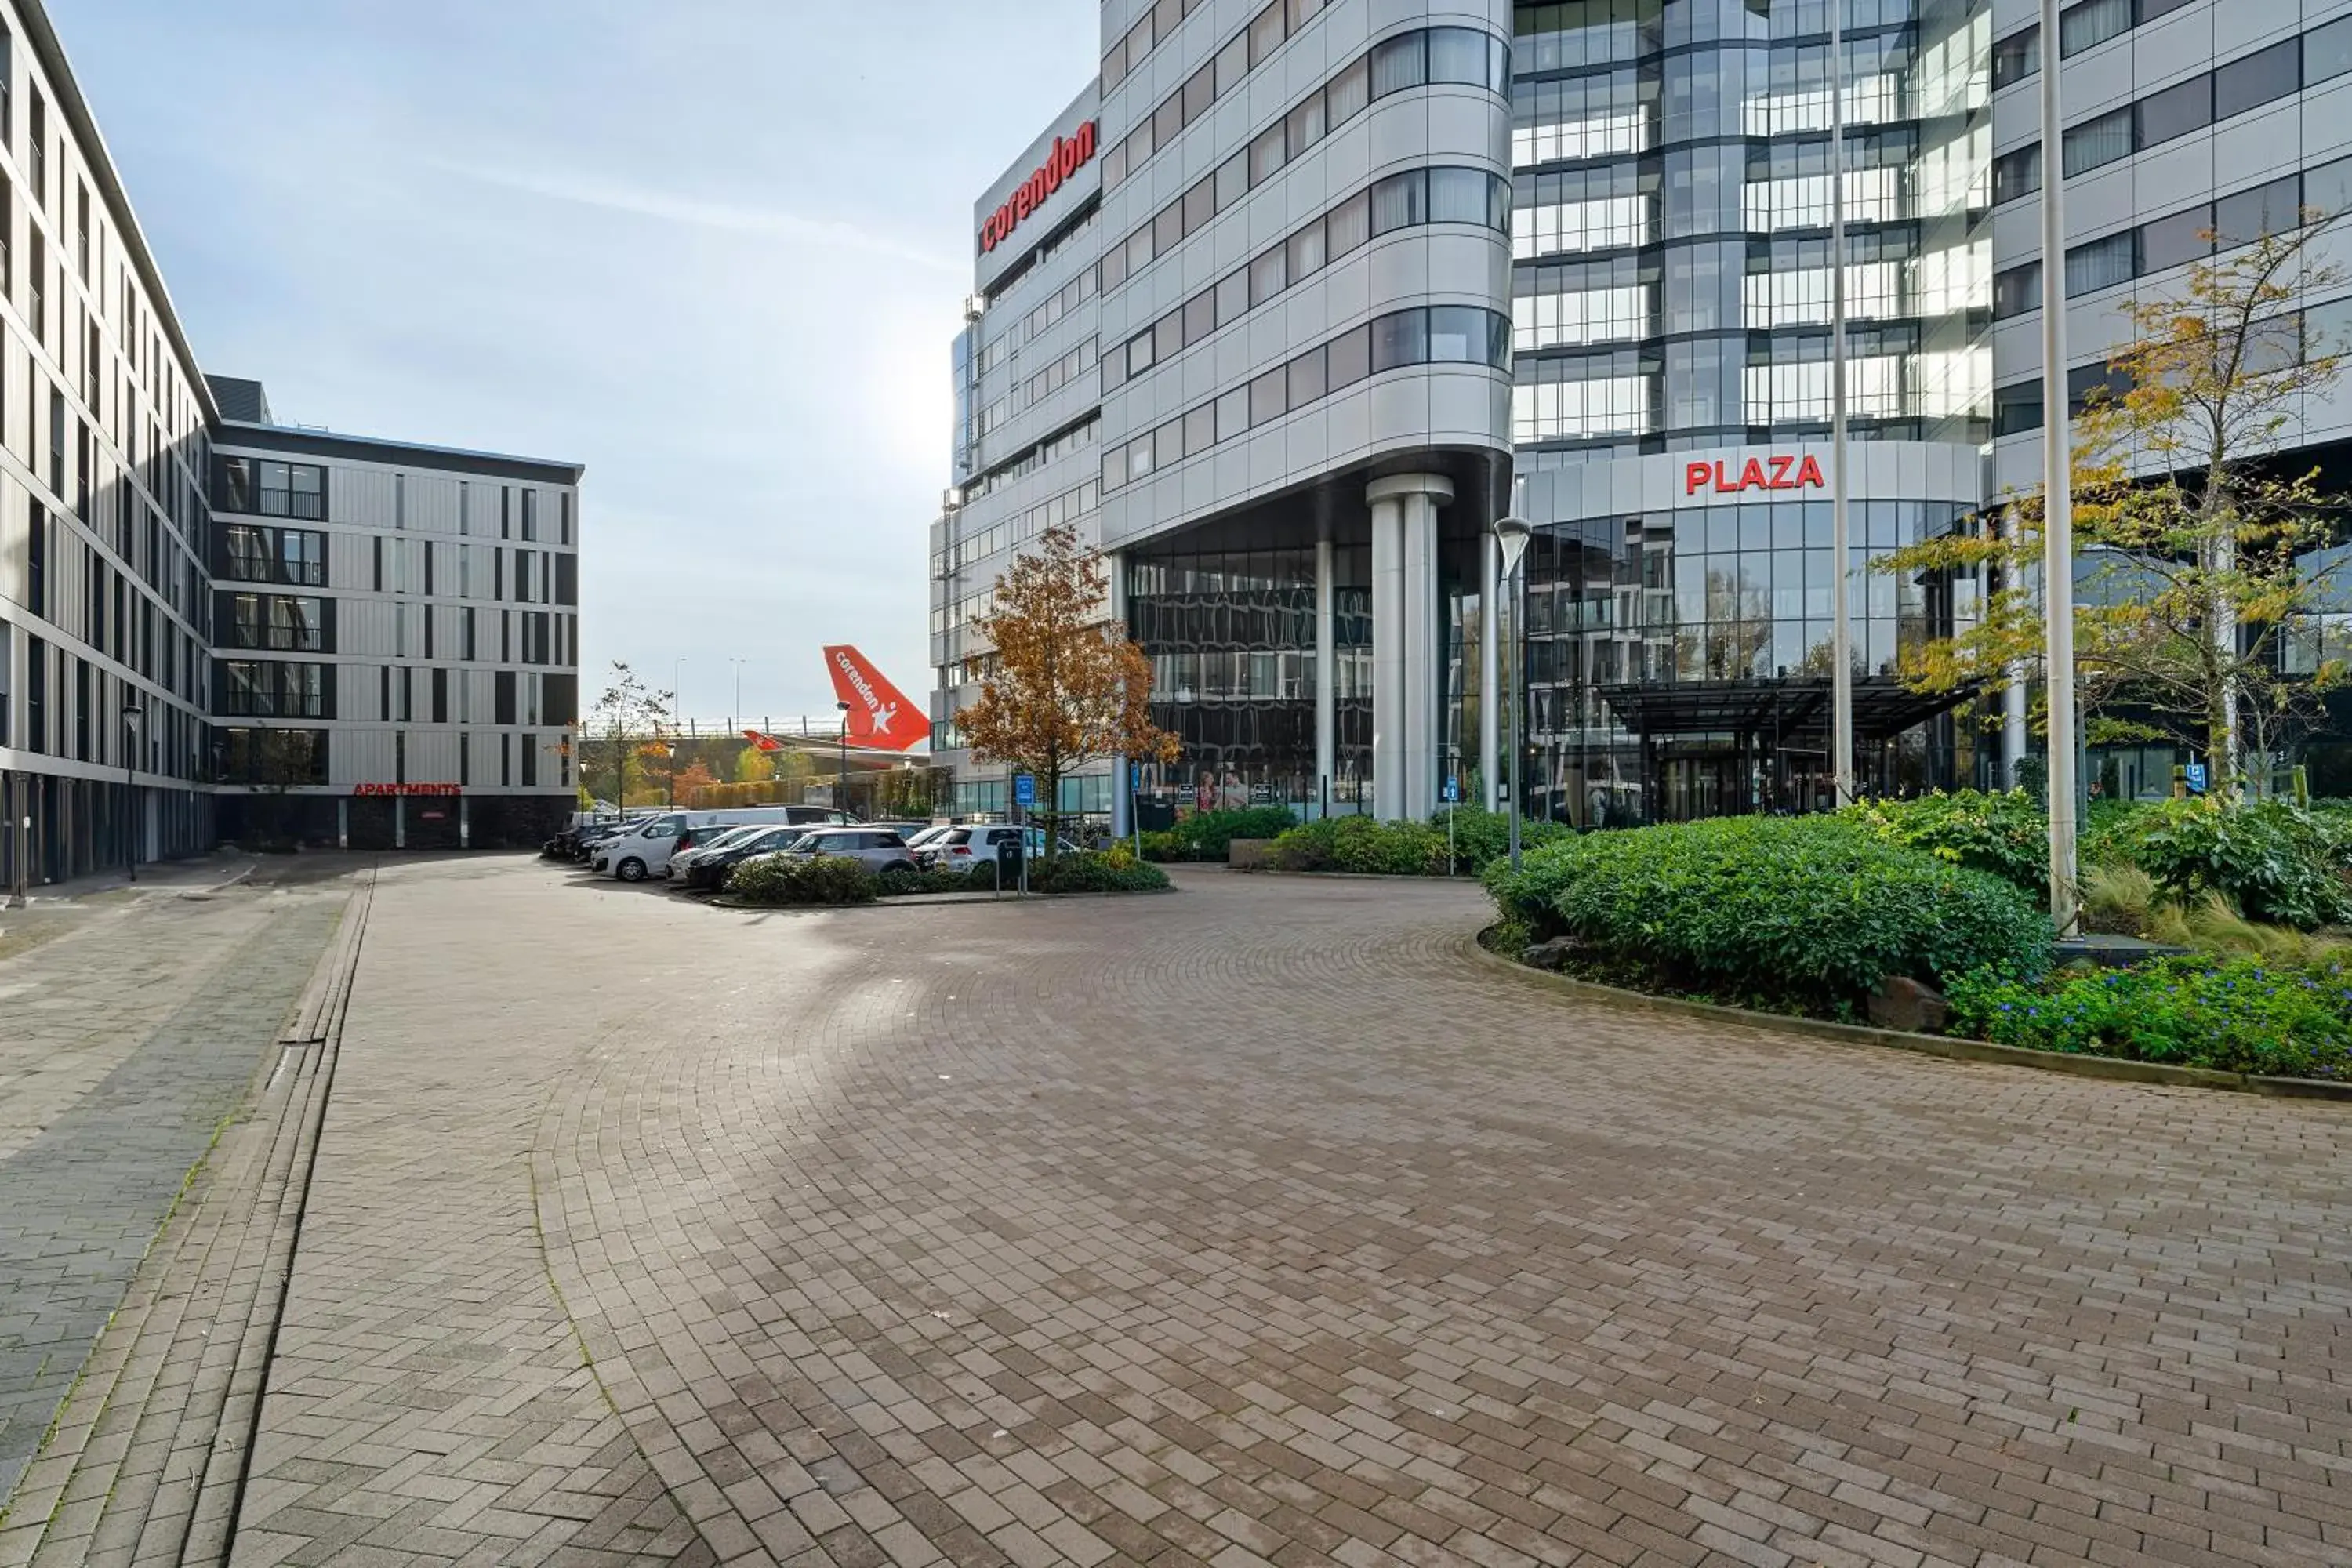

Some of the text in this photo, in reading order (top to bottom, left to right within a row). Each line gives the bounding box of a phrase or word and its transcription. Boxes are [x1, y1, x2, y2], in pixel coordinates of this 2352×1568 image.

[982, 120, 1095, 252] corendon
[1686, 455, 1824, 495] PLAZA
[836, 652, 878, 709] corendon
[354, 782, 462, 796] APARTMENTS
